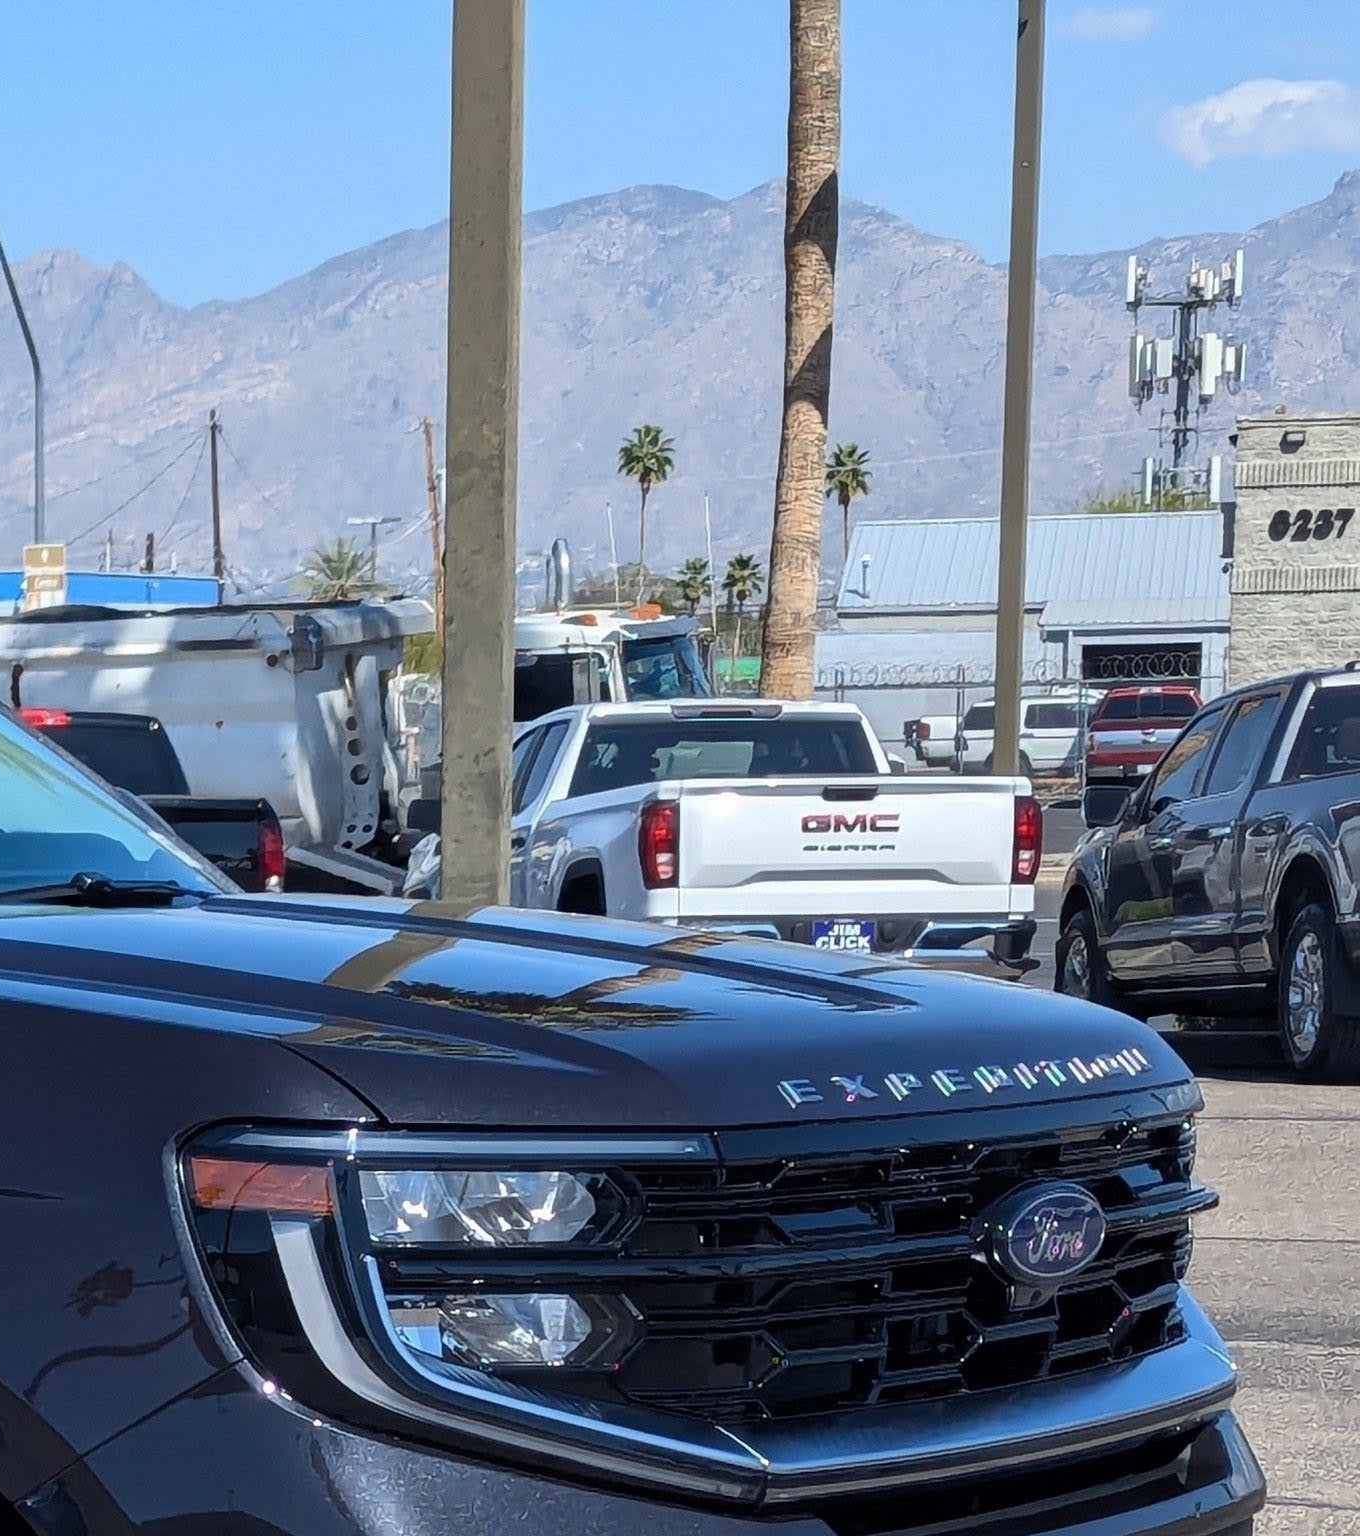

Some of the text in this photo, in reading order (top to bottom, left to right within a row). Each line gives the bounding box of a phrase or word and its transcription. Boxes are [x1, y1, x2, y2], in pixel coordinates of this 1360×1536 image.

[801, 814, 900, 833] GMC
[828, 924, 861, 936] JIM
[815, 936, 871, 950] CLICK
[1024, 1205, 1092, 1264] Ford
